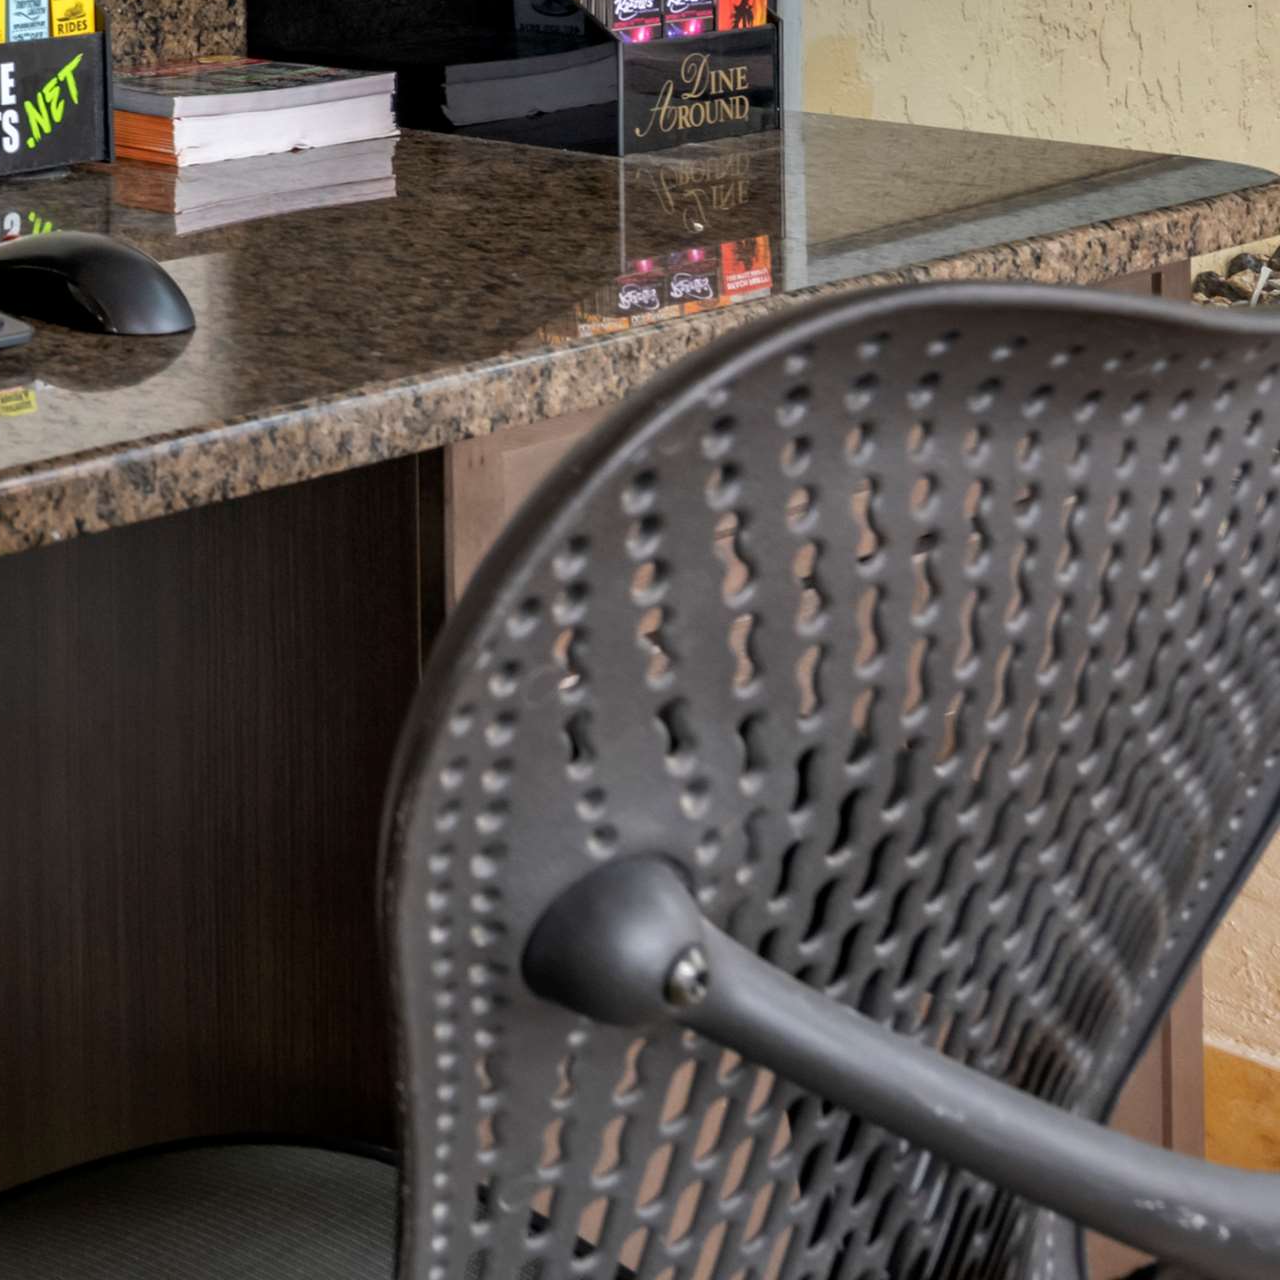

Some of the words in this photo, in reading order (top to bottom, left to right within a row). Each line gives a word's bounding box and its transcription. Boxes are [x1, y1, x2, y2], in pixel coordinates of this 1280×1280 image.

[57, 20, 88, 34] RIDES
[24, 53, 83, 148] .NET
[681, 53, 749, 100] DINE
[635, 80, 749, 137] AROUND
